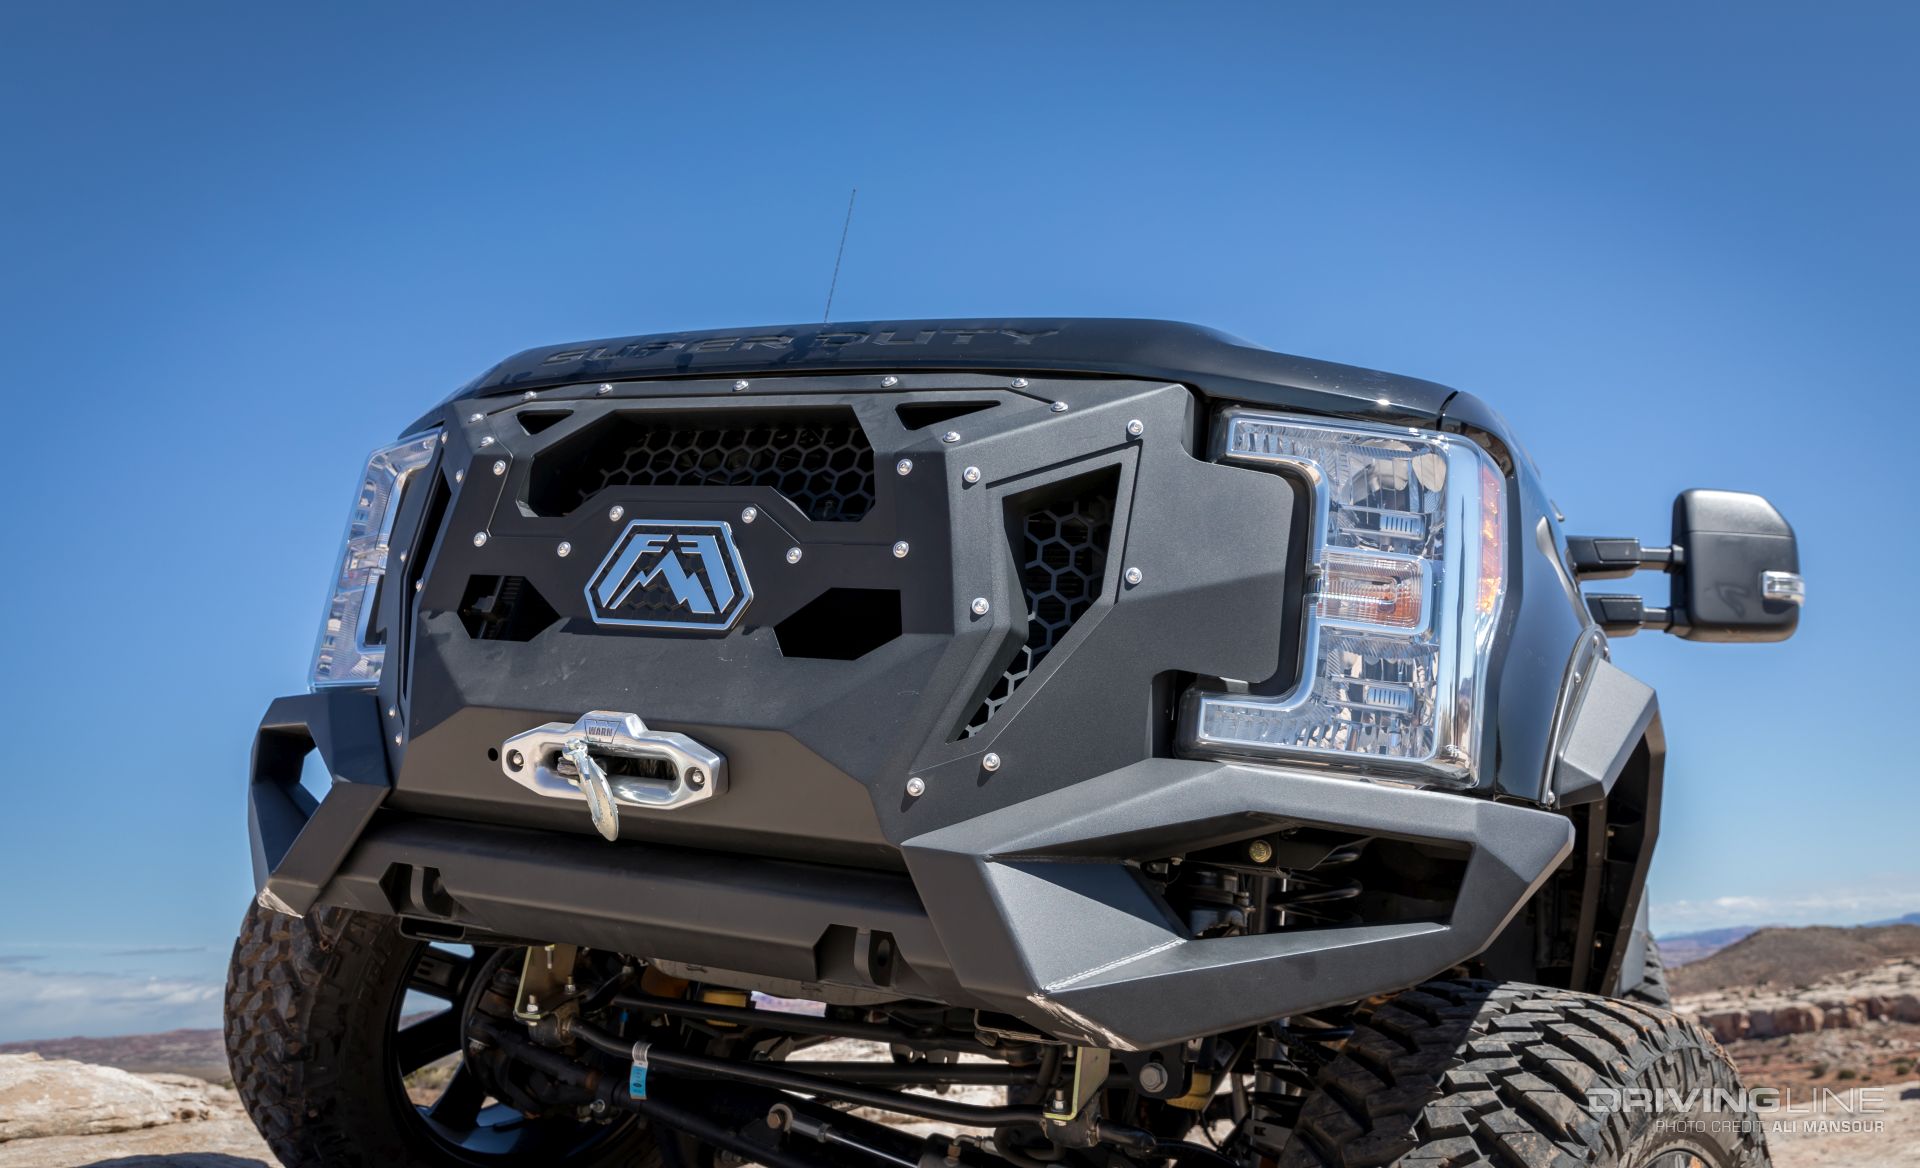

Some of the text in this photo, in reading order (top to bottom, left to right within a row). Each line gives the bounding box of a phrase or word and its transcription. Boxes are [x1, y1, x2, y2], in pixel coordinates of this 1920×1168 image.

[541, 328, 1060, 368] SUPER DUTY
[588, 726, 613, 736] WARN
